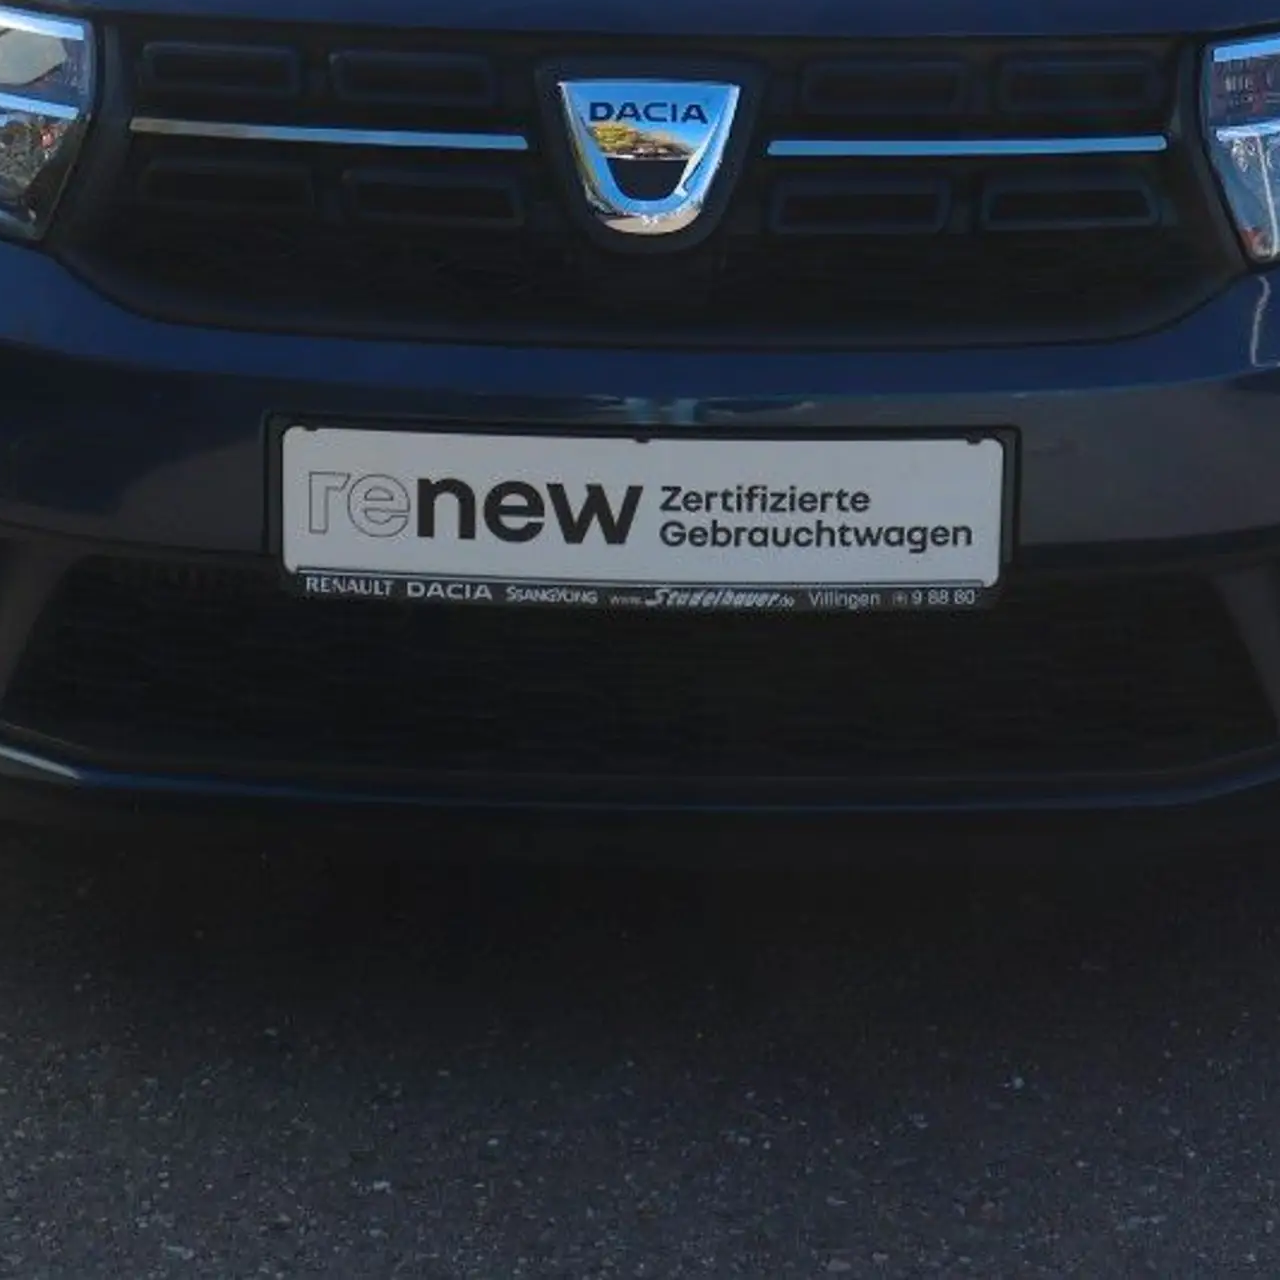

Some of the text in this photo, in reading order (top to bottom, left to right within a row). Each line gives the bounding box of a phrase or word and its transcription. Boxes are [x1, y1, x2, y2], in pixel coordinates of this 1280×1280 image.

[589, 102, 708, 124] DACIA
[308, 471, 644, 545] renew
[659, 485, 871, 513] Zertifizierte
[659, 520, 973, 553] Gebrauchtwagen
[306, 576, 395, 596] RENAULT
[407, 581, 492, 600] DACIA
[809, 590, 881, 610] Villingen
